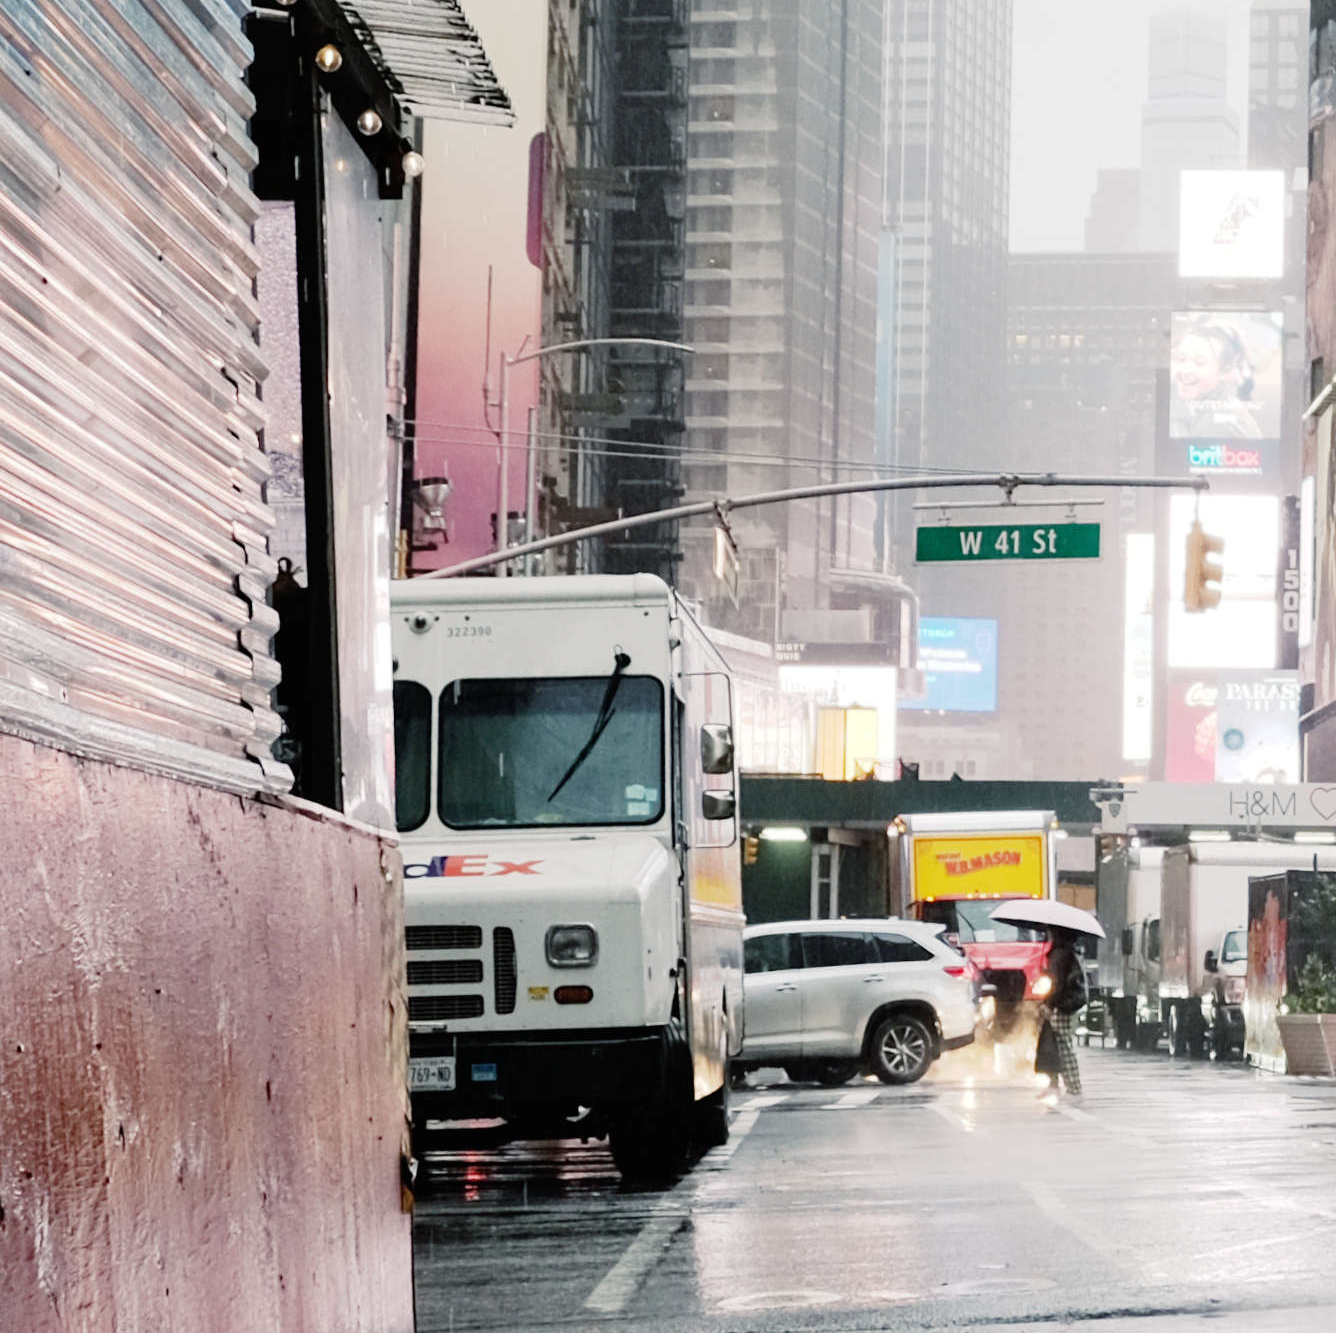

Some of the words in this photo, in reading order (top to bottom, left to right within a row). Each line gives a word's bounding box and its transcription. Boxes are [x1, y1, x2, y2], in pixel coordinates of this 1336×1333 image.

[1188, 443, 1260, 466] britbox
[959, 530, 983, 555] W
[995, 530, 1020, 555] 41
[1032, 529, 1057, 554] St
[1283, 549, 1300, 632] 1500
[1230, 790, 1296, 816] H&M
